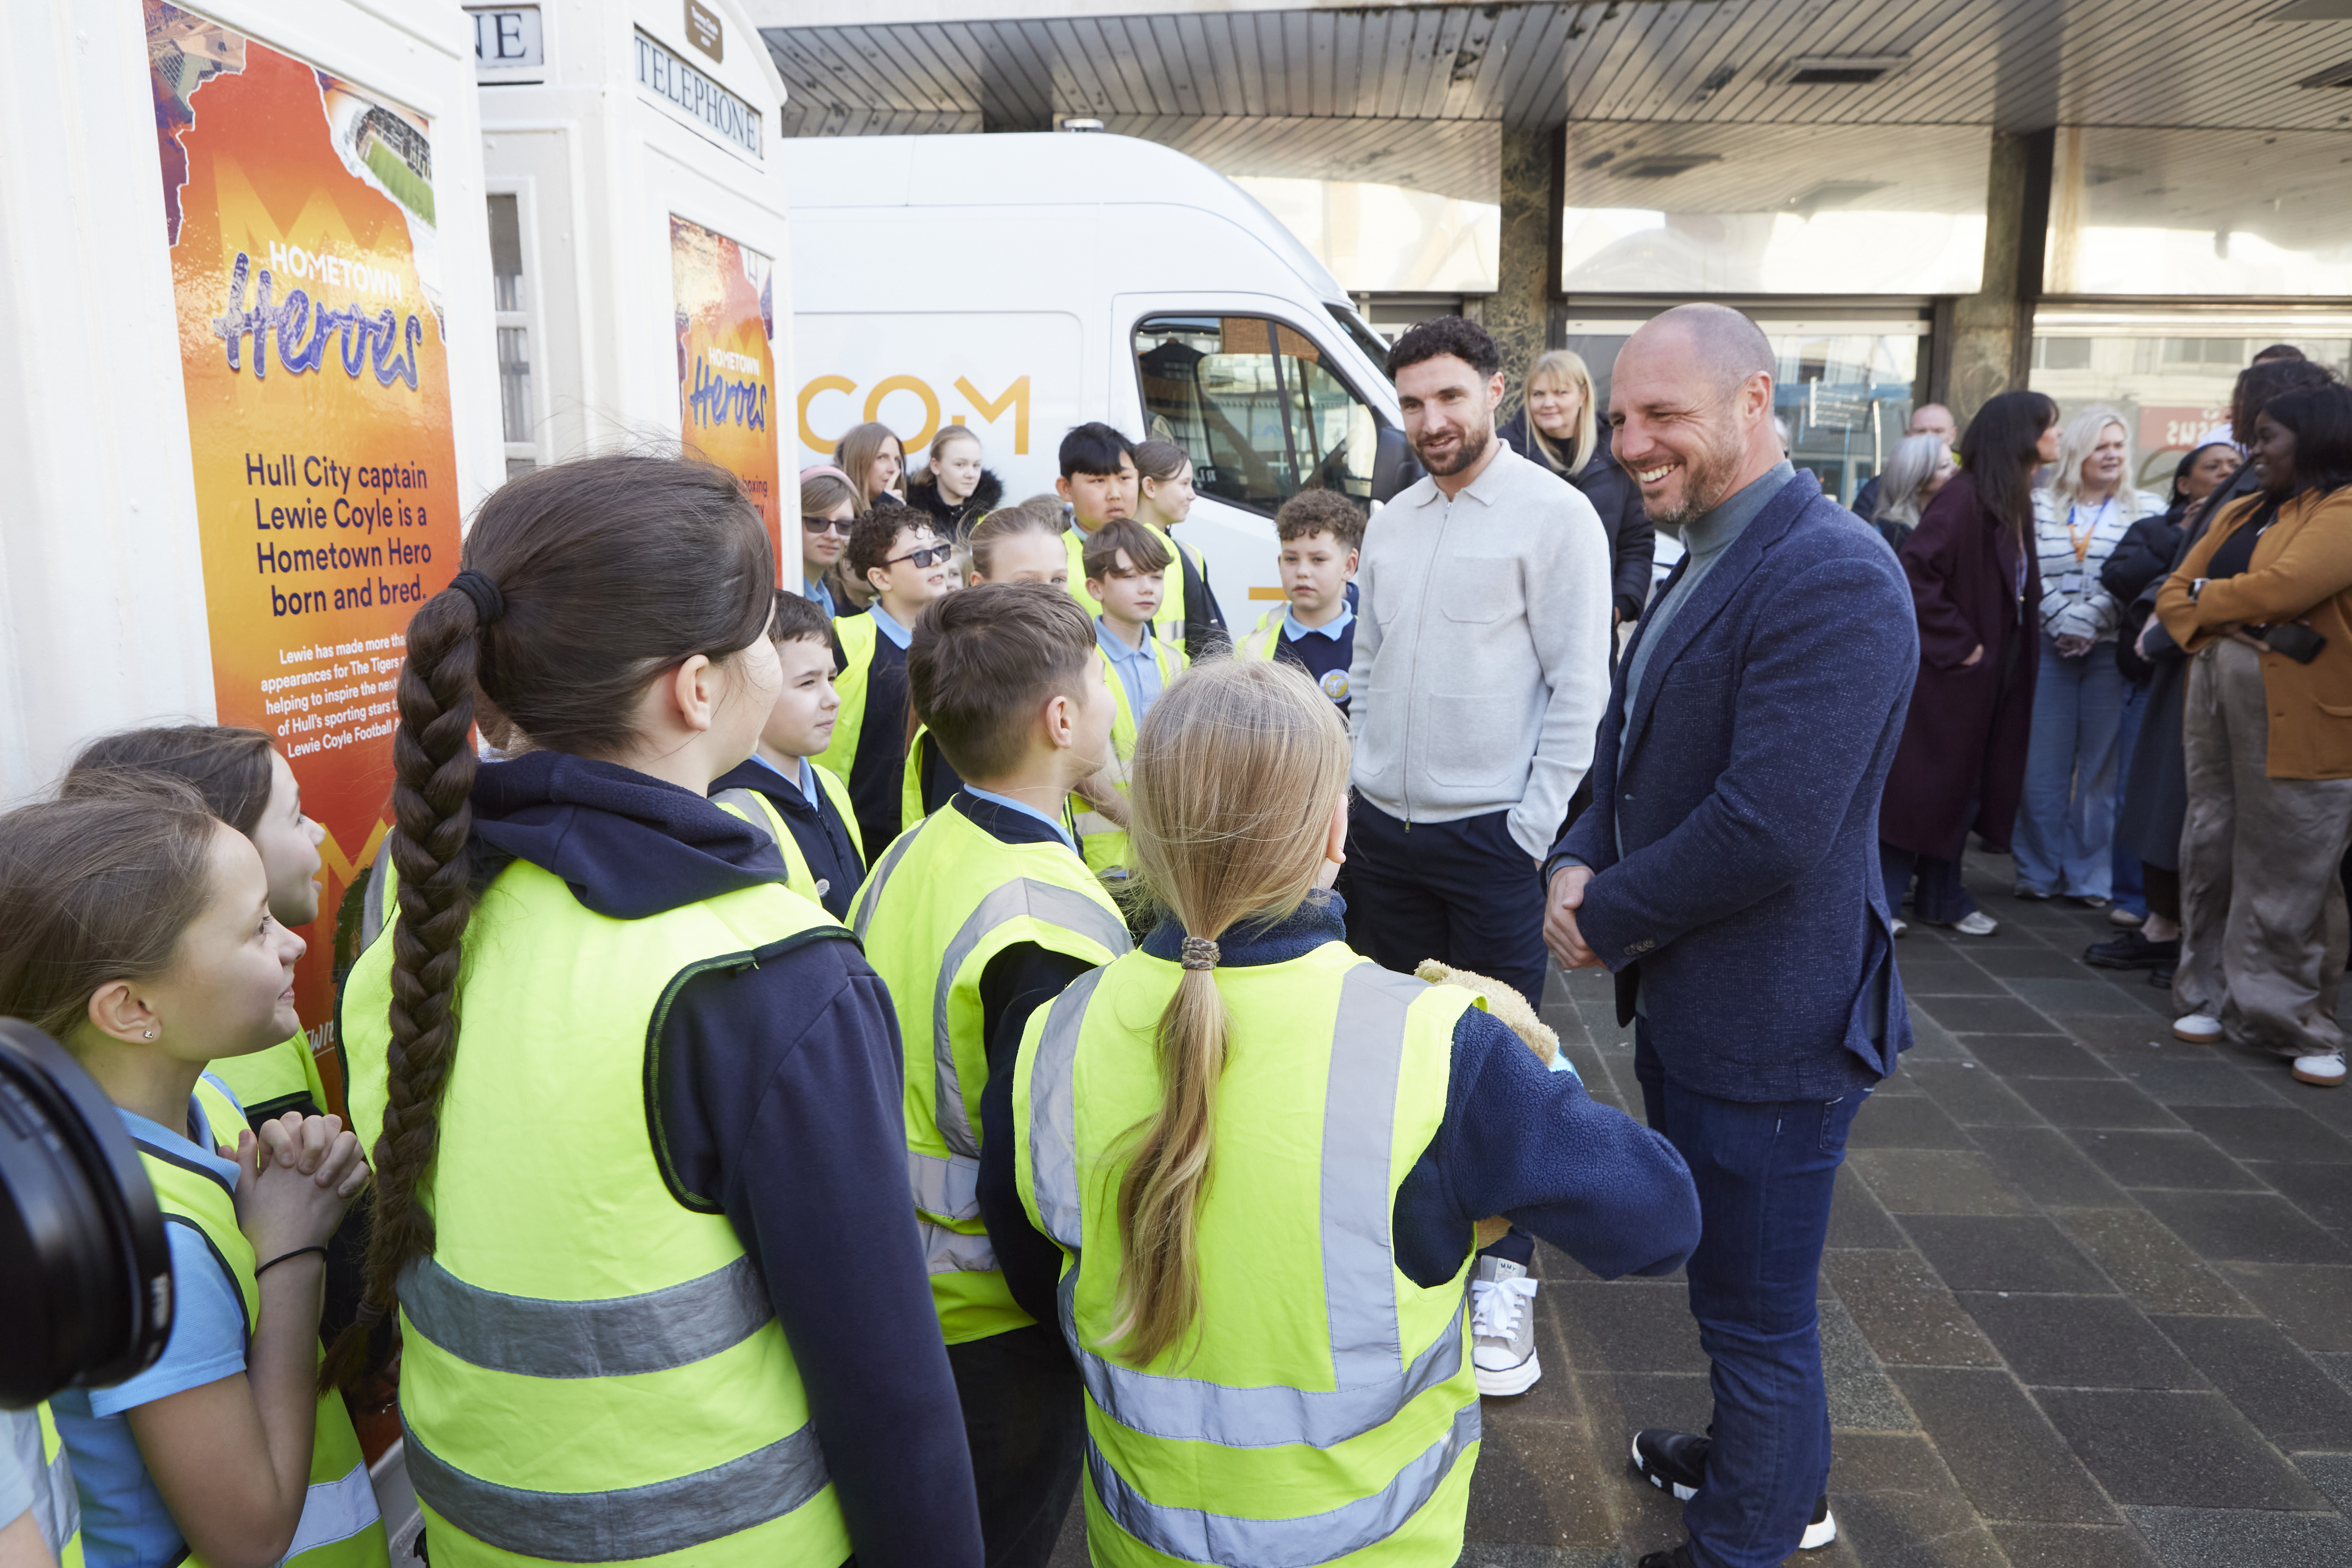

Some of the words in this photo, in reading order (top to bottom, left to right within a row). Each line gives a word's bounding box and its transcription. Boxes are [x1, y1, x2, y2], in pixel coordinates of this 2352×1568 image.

[635, 36, 756, 152] TELEPHONE
[269, 240, 401, 301] HOMETOWN
[213, 251, 422, 389] Heroes
[708, 346, 760, 377] HOMETOWN
[689, 355, 767, 432] Heroes
[245, 453, 296, 486] Hull
[304, 456, 351, 494] City
[358, 461, 427, 495] captain
[255, 497, 327, 530] Lewie
[334, 498, 393, 535] Coyle
[398, 498, 412, 526] is
[417, 506, 427, 526] a
[257, 542, 383, 574] Hometown
[388, 537, 431, 565] Hero
[271, 585, 327, 616] born
[334, 577, 372, 610] and
[379, 573, 427, 605] bred.
[279, 645, 313, 665] Lewie
[315, 644, 334, 659] has
[336, 638, 364, 656] made
[365, 637, 389, 652] more
[391, 633, 406, 647] tha
[261, 669, 332, 694] appearances
[333, 664, 349, 679] for
[349, 660, 369, 676] The
[370, 656, 399, 674] Tigers
[266, 694, 309, 715] helping
[310, 692, 322, 706] to
[324, 684, 358, 704] inspire
[360, 681, 377, 696] the
[378, 677, 397, 692] next
[278, 719, 289, 736] of
[292, 714, 323, 733] Hull's
[325, 705, 366, 729] sporting
[368, 701, 390, 716] stars
[288, 737, 321, 758] Lewie
[322, 730, 353, 749] Coyle
[355, 719, 392, 741] Football
